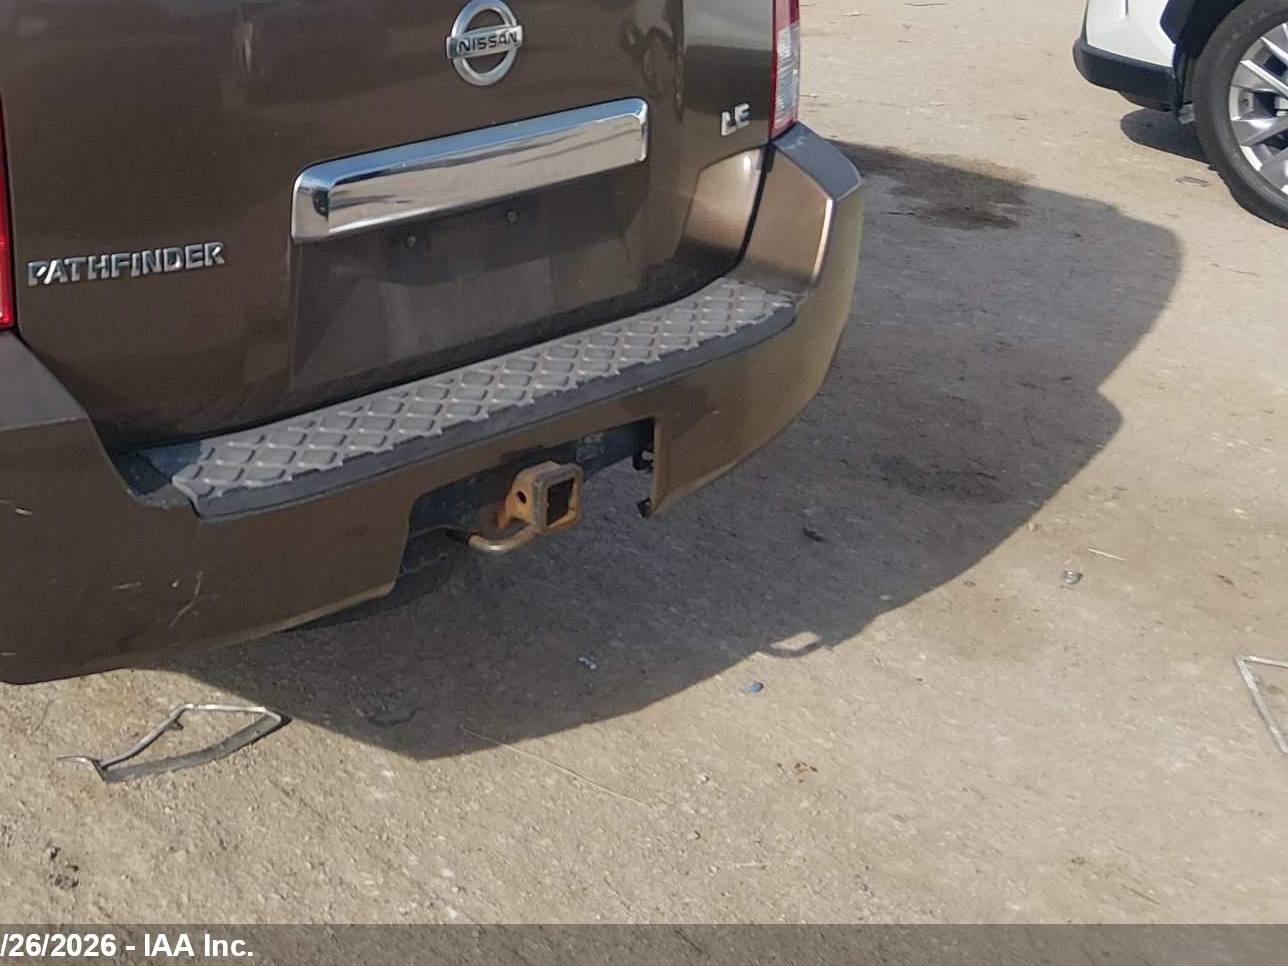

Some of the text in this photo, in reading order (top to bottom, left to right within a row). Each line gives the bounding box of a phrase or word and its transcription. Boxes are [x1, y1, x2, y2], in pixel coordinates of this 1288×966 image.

[458, 30, 518, 53] NISSAN
[720, 103, 751, 136] LE
[27, 241, 226, 286] PATHFINDER
